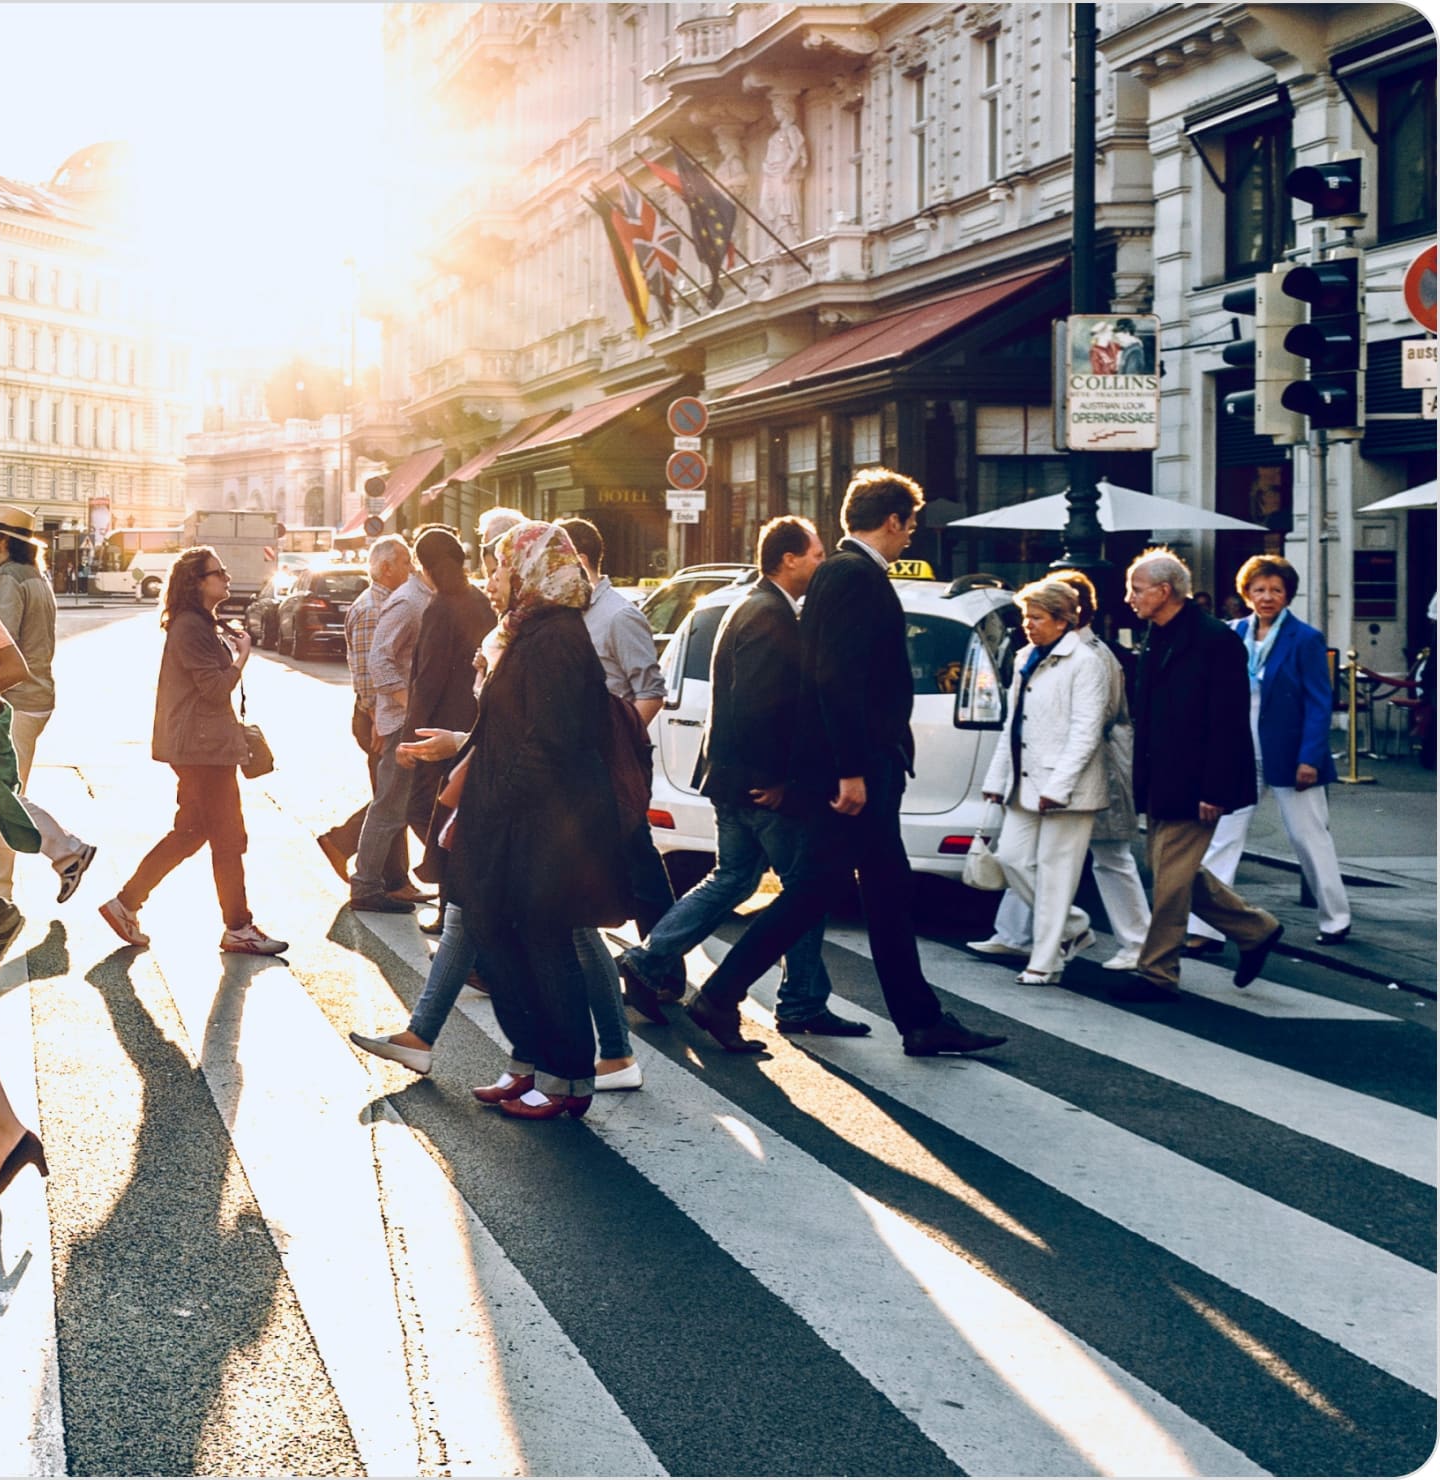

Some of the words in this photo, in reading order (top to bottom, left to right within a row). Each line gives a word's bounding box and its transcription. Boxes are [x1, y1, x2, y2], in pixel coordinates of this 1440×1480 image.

[1071, 375, 1158, 390] COLLINS
[1080, 402, 1121, 410] AUSTRIAN
[1123, 402, 1146, 410] LOOK
[1072, 412, 1156, 424] OPERNPASSAGE
[598, 489, 648, 502] HOTEL
[888, 562, 920, 576] AXI
